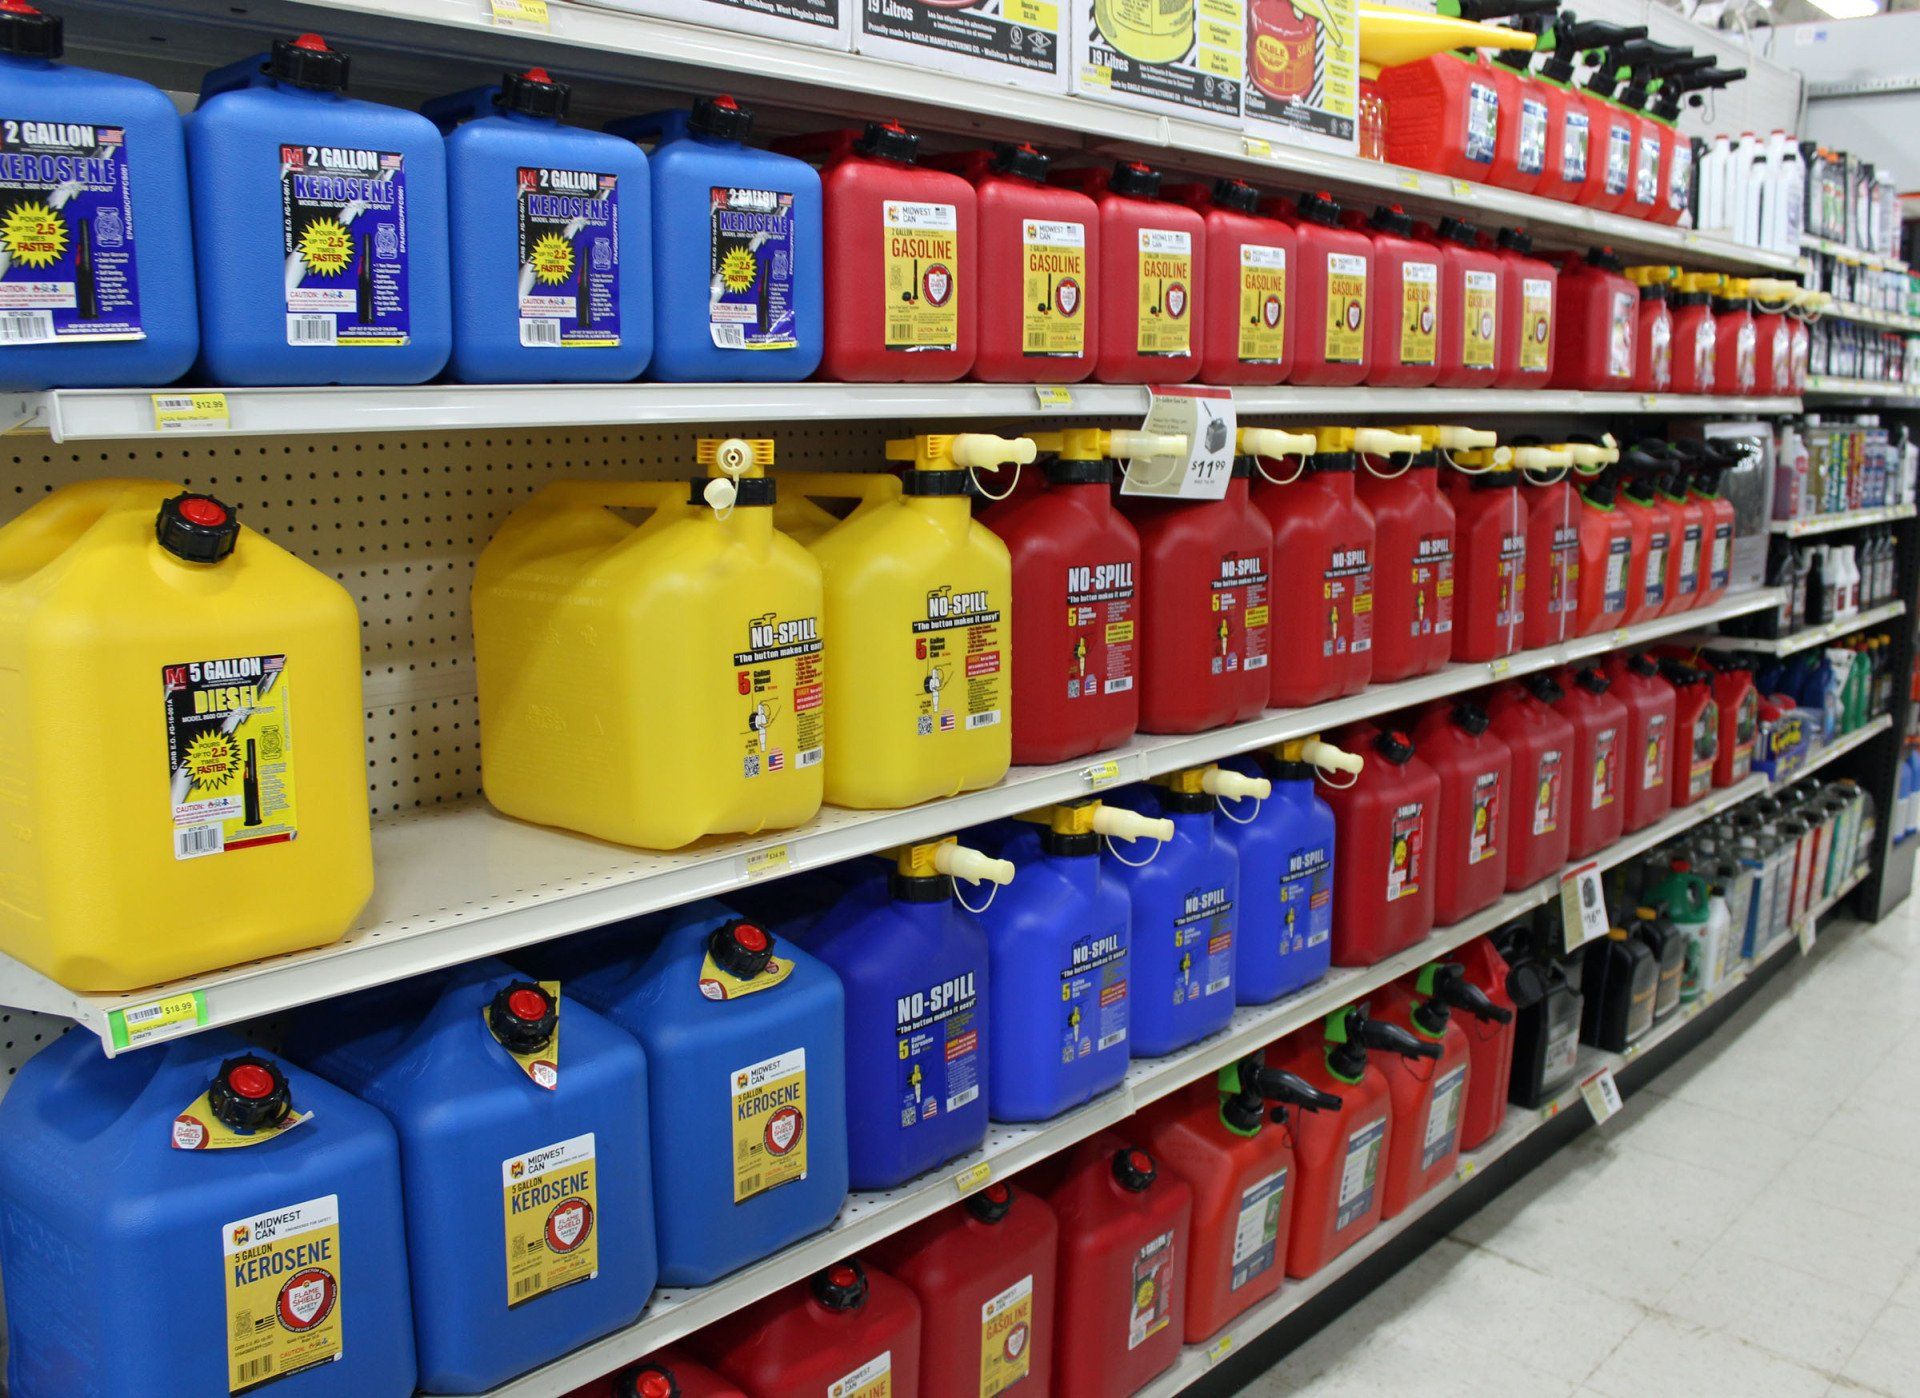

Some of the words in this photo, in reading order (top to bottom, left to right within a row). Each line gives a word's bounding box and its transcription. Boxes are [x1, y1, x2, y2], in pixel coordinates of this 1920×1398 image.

[882, 0, 914, 21] Litros
[1092, 49, 1101, 64] 19
[1104, 51, 1129, 72] Litres
[4, 120, 20, 144] 2
[22, 122, 95, 147] GALLON
[307, 147, 318, 166] 2
[321, 148, 378, 170] GALLON
[293, 174, 394, 203] KEROSENE
[540, 170, 549, 188] 2
[552, 170, 597, 191] GALLON
[528, 195, 609, 221] KEROSENE
[902, 206, 932, 216] MIDWEST
[36, 224, 56, 235] 2.5
[720, 211, 787, 234] KEROSENE
[18, 243, 54, 252] FASTER
[328, 237, 344, 248] 2.5
[892, 238, 952, 259] GASOLINE
[312, 254, 342, 262] FASTER
[554, 250, 566, 260] 2.5
[1030, 254, 1080, 274] GASOLINE
[739, 262, 750, 270] 2.5
[1144, 260, 1187, 279] GASOLINE
[1245, 274, 1282, 292] GASOLINE
[1222, 558, 1260, 578] NO-SPILL
[1333, 550, 1366, 568] NO-SPILL
[1068, 562, 1133, 593] NO-SPILL
[928, 591, 988, 618] NO-SPILL
[1080, 594, 1098, 602] button
[1212, 594, 1220, 611] 5
[930, 620, 952, 629] button
[954, 617, 974, 627] makes
[1068, 607, 1076, 627] 5
[752, 617, 817, 649] NO-SPILL
[754, 649, 779, 660] button
[780, 645, 802, 658] makes
[916, 638, 927, 660] 5
[189, 663, 201, 683] 5
[204, 657, 261, 681] GALLON
[738, 671, 751, 695] 5
[194, 685, 260, 715] DIESEL
[212, 746, 228, 758] 2.5
[197, 763, 227, 775] FASTER
[176, 804, 204, 813] CAUTION:
[1290, 849, 1324, 872] NO-SPILL
[1185, 888, 1225, 914] NO-SPILL
[1280, 887, 1288, 902] 5
[1175, 930, 1183, 947] 5
[1073, 934, 1117, 964] NO-SPILL
[898, 972, 976, 1024] NO-SPILL
[1062, 983, 1070, 1001] 5
[165, 1002, 192, 1014] $18.99
[912, 1018, 933, 1031] button
[934, 1010, 952, 1022] makes
[899, 1039, 909, 1060] 5
[751, 1060, 781, 1075] MIDWEST
[751, 1075, 764, 1084] CAN
[738, 1082, 800, 1121] KEROSENE
[743, 1087, 763, 1100] GALLON
[528, 1147, 565, 1166] MIDWEST
[528, 1162, 545, 1174] CAN
[512, 1185, 516, 1194] 5
[518, 1176, 543, 1191] GALLON
[512, 1171, 589, 1215] KEROSENE
[254, 1210, 301, 1231] MIDWEST
[558, 1219, 580, 1231] SHIELD
[255, 1227, 276, 1240] CAN
[235, 1253, 240, 1263] 5
[242, 1243, 273, 1261] GALLON
[235, 1238, 332, 1288] KEROSENE
[292, 1292, 321, 1307] SHIELD
[294, 1287, 319, 1300] FLAME
[296, 1302, 317, 1312] SAFETY
[987, 1302, 1027, 1340] GASOLINE
